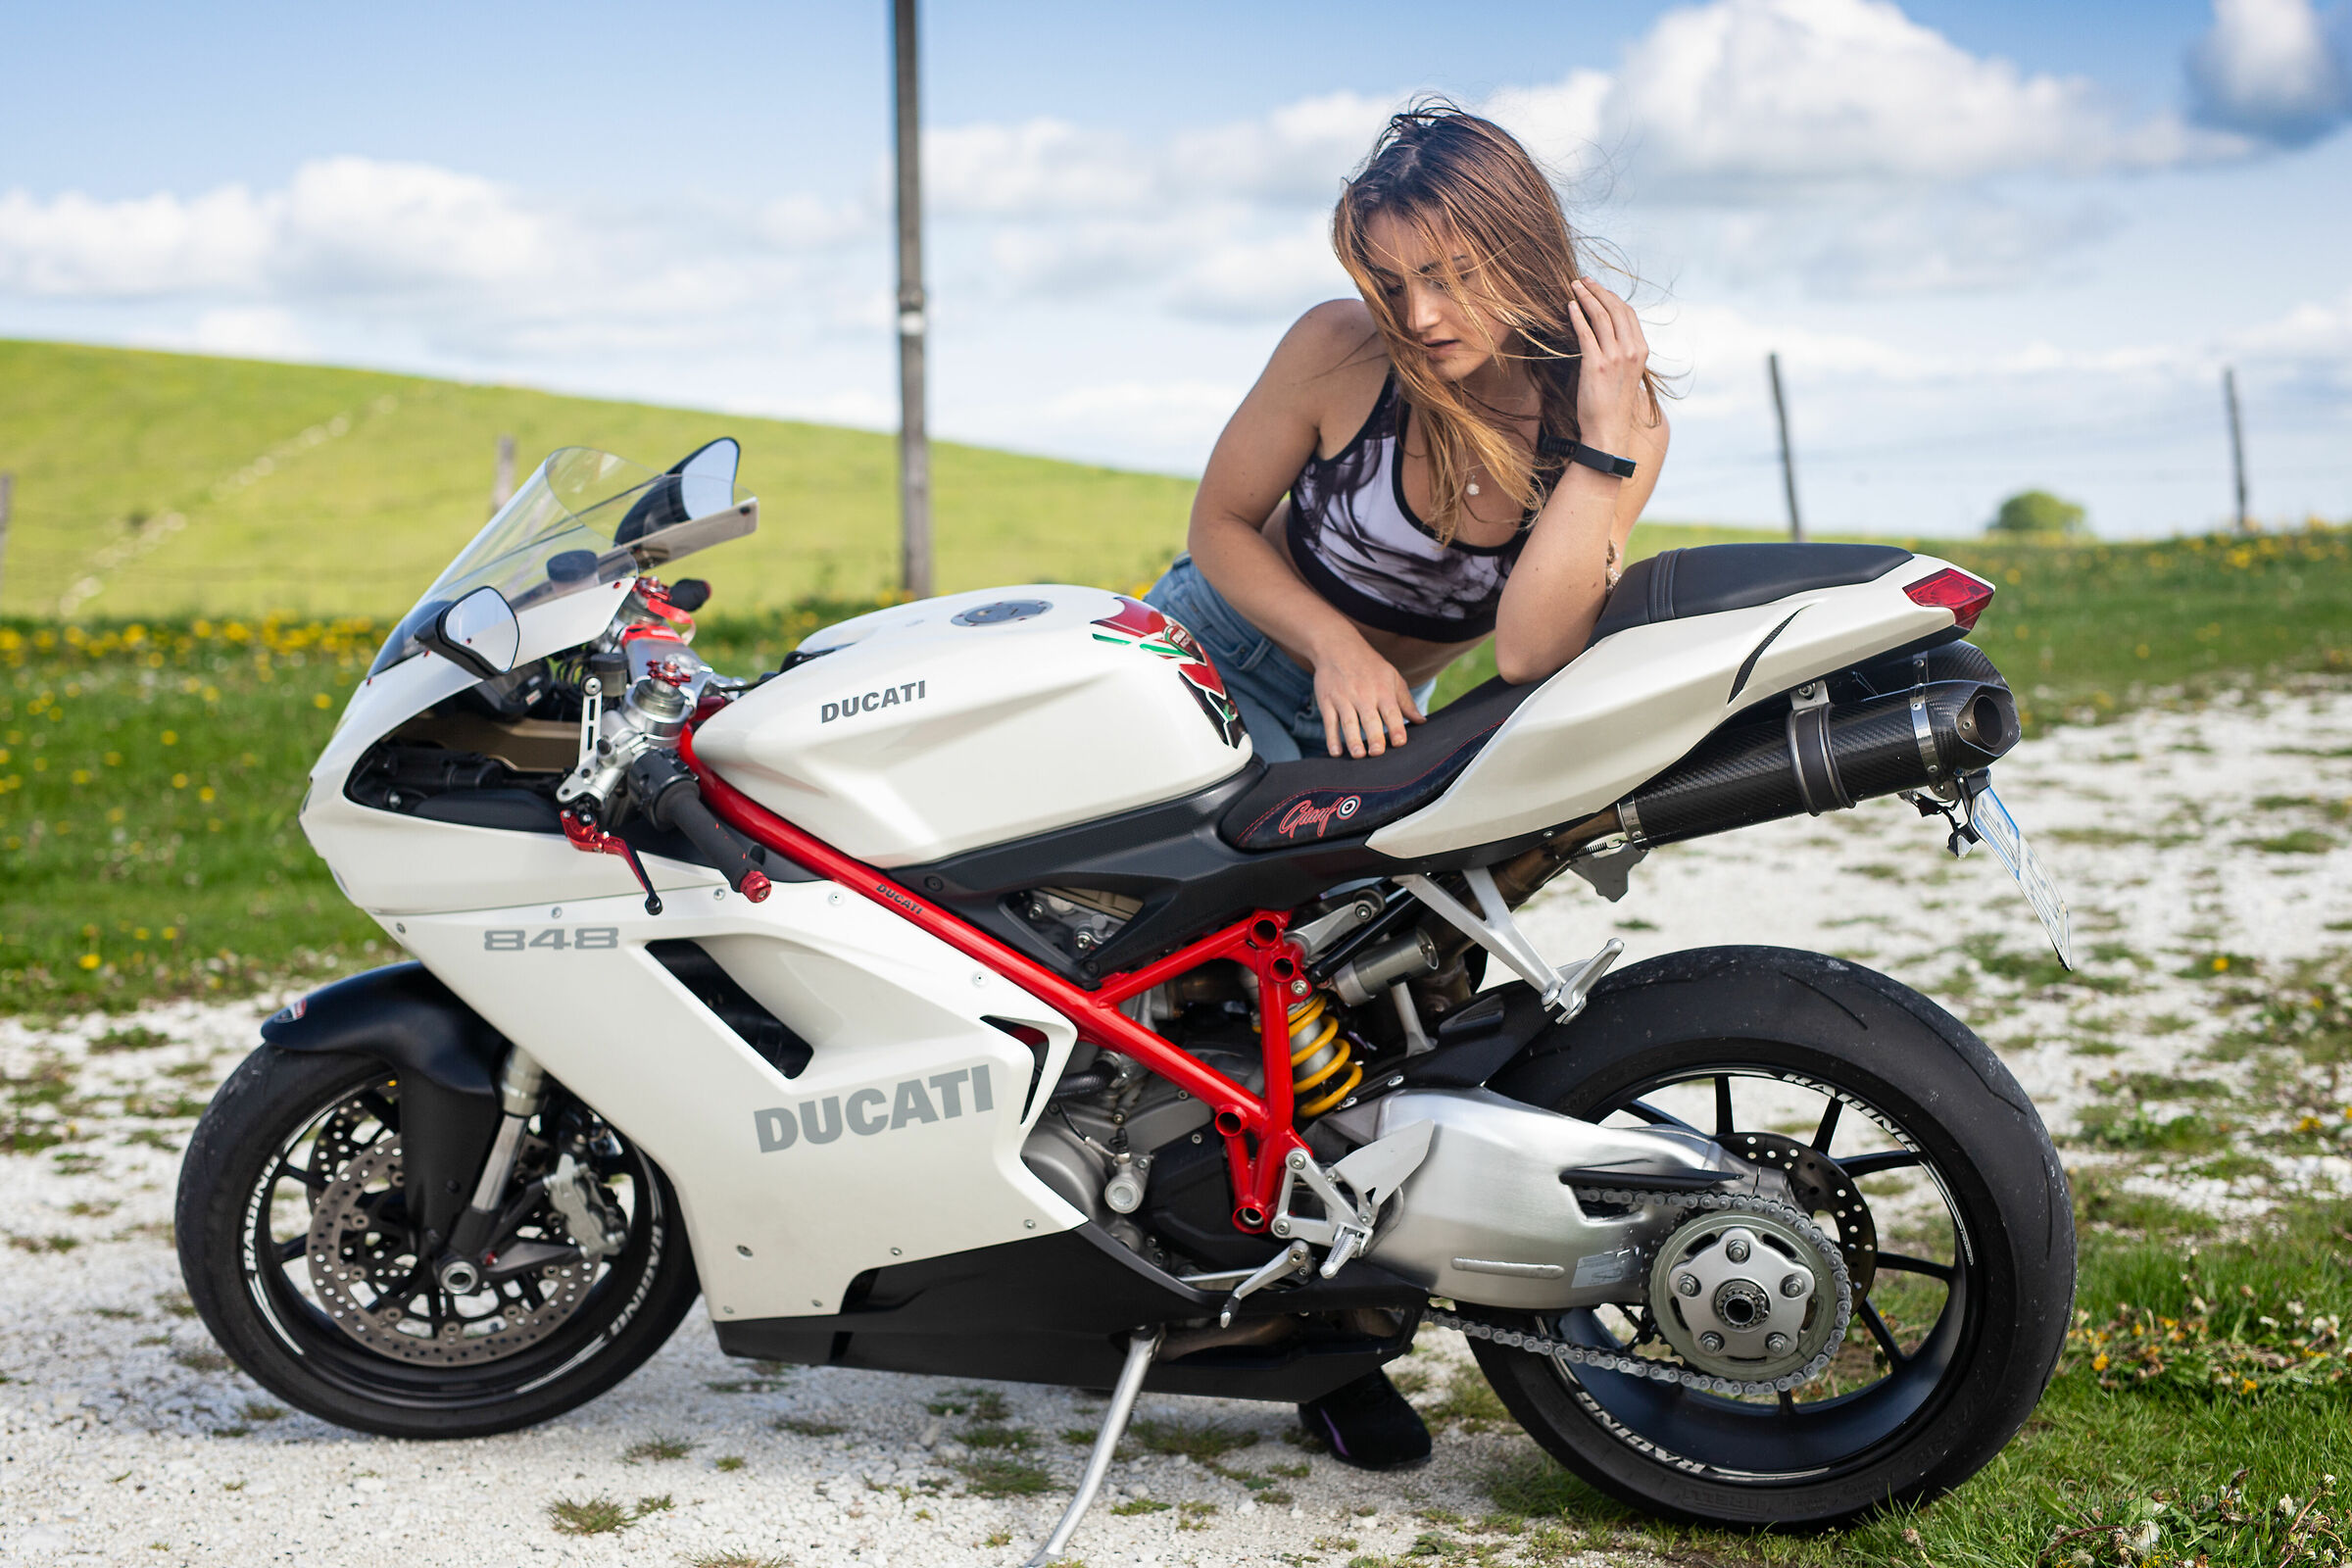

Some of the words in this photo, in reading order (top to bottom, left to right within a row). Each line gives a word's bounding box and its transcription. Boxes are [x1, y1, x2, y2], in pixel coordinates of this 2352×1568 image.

[821, 680, 925, 723] DUCATI
[484, 927, 619, 951] 848
[876, 883, 923, 915] DUCATI
[754, 1064, 994, 1153] DUCATI
[1783, 1073, 1921, 1153] RACING
[243, 1154, 280, 1271] RACING
[610, 1225, 662, 1337] RACING
[1576, 1392, 1706, 1474] RACING
